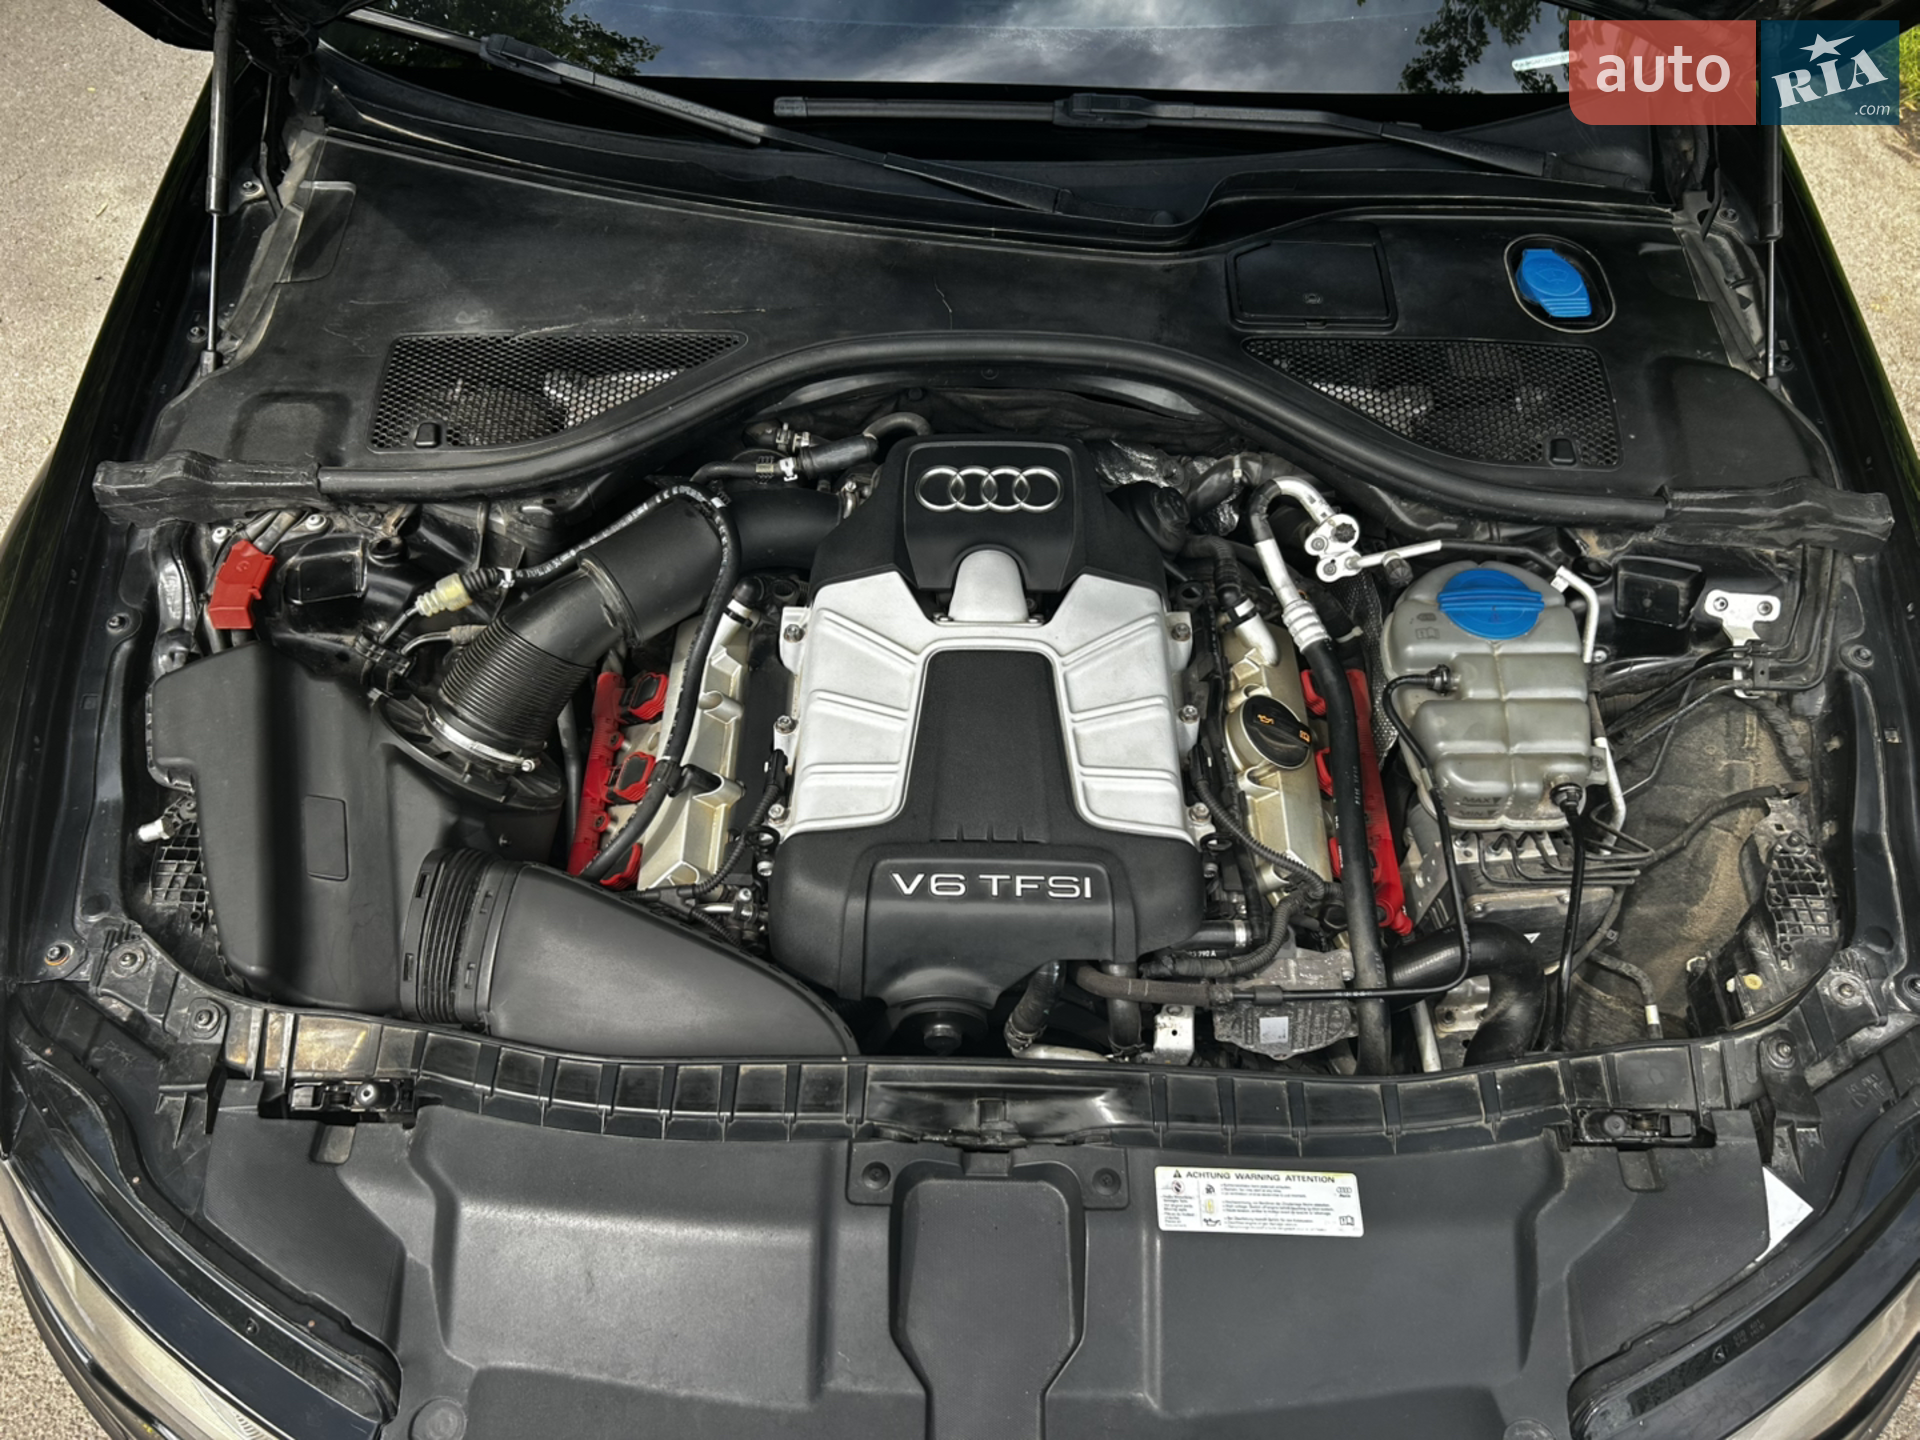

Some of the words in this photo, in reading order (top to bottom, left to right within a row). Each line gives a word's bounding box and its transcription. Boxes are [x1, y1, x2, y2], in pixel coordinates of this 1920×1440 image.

[1463, 796, 1490, 804] MAX
[1459, 809, 1483, 817] MIN
[891, 873, 967, 896] V6
[979, 874, 1092, 899] TFSI
[1186, 1170, 1231, 1180] ACHTUNG
[1235, 1173, 1281, 1182] WARNING
[1285, 1175, 1336, 1184] ATTENTION
